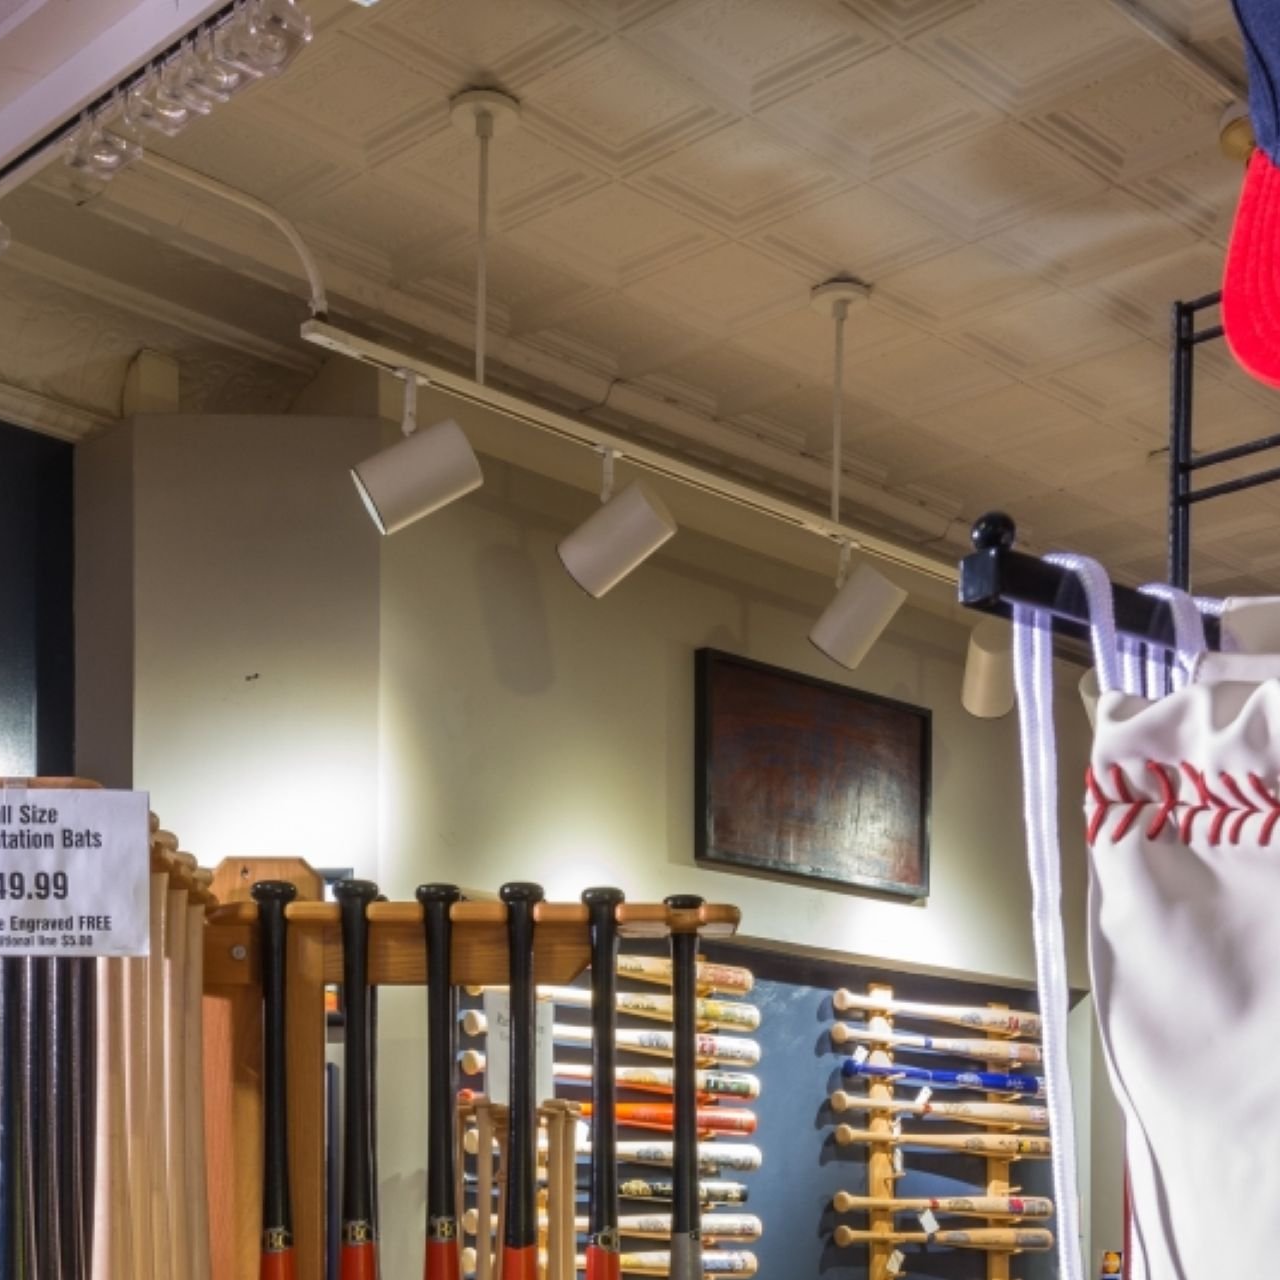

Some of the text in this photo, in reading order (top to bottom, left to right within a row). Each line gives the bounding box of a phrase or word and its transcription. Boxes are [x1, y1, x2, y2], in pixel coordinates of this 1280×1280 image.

[19, 804, 58, 825] Size
[61, 829, 103, 849] Bats
[9, 915, 74, 935] Engraved
[78, 915, 112, 932] FREE
[36, 934, 57, 948] line
